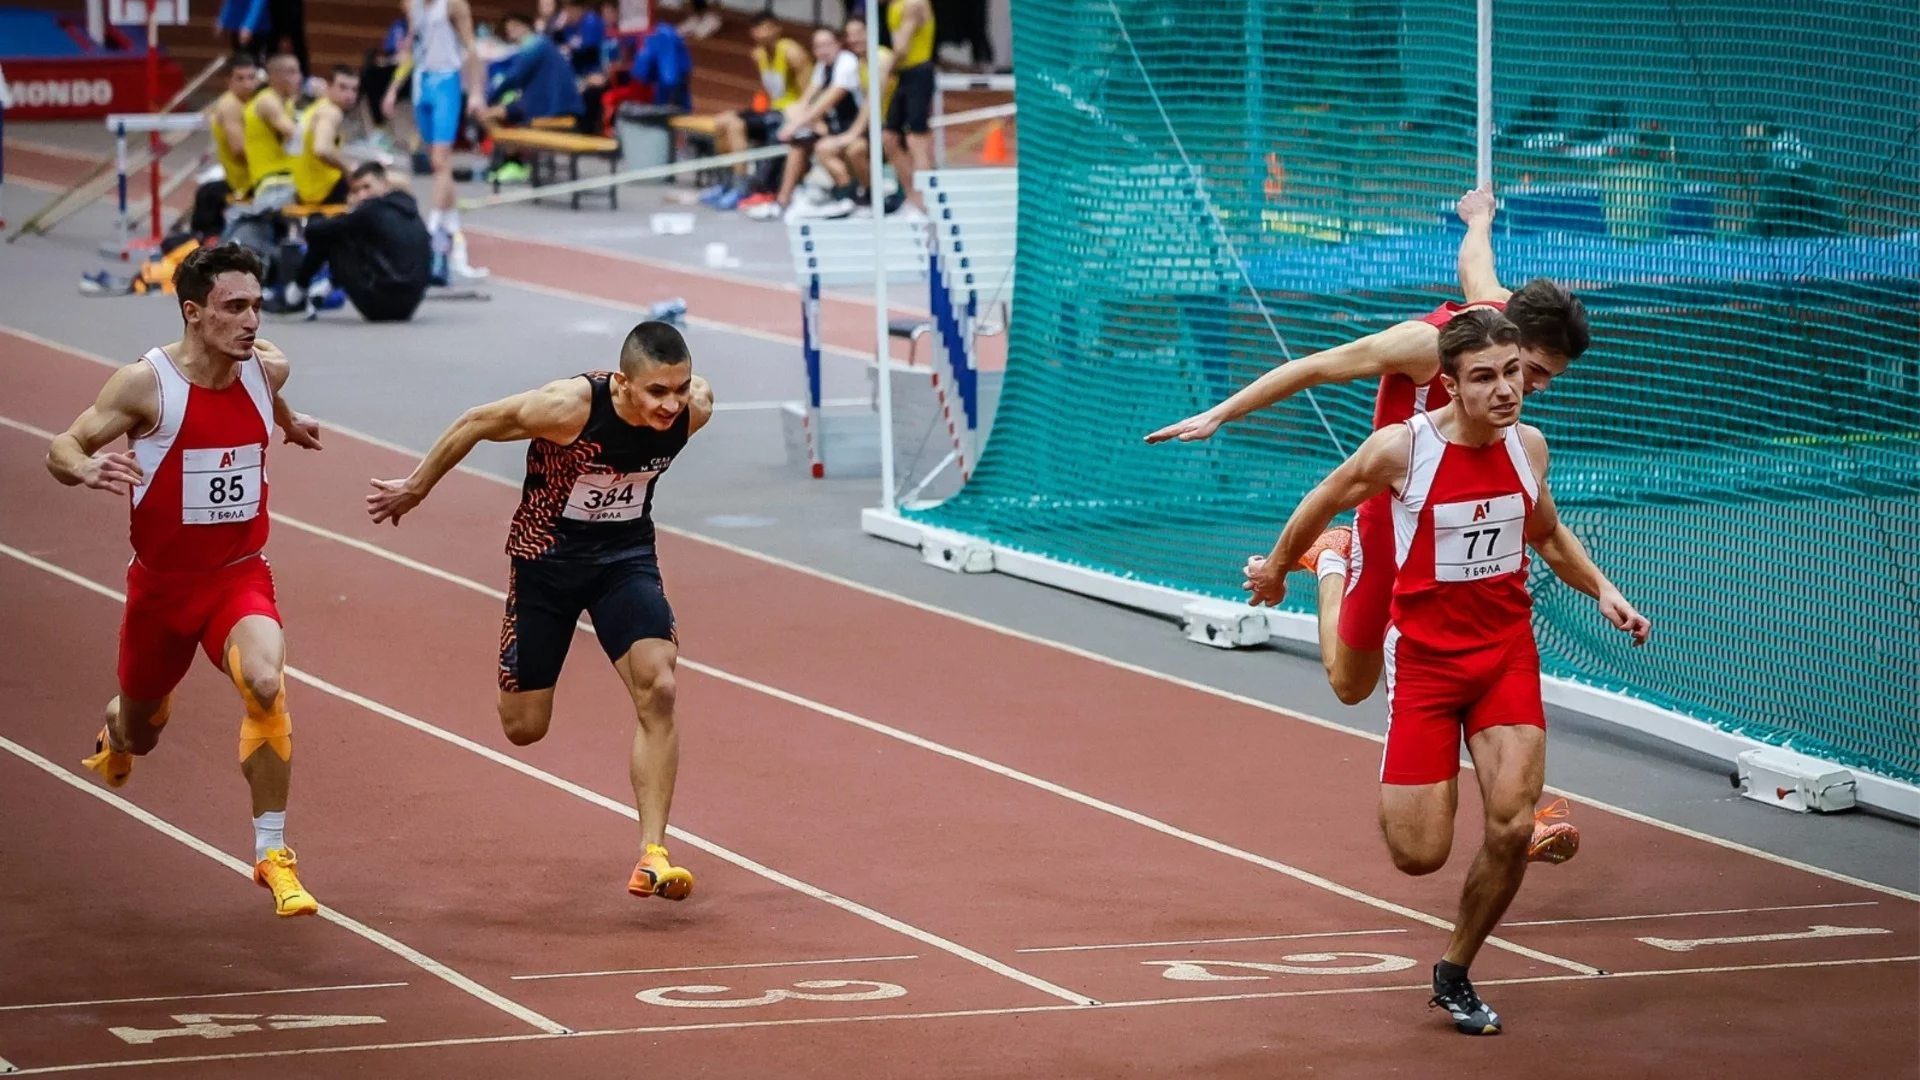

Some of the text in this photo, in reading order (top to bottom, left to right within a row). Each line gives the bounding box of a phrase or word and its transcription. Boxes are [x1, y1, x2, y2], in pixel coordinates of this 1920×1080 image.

[219, 449, 236, 469] A1
[209, 474, 244, 504] 85
[584, 483, 634, 510] 384
[1472, 501, 1490, 522] A1
[1463, 528, 1501, 560] 77
[1636, 925, 1892, 952] 1
[1142, 952, 1418, 982] 2
[635, 980, 909, 1009] 3
[109, 1013, 387, 1045] 4
